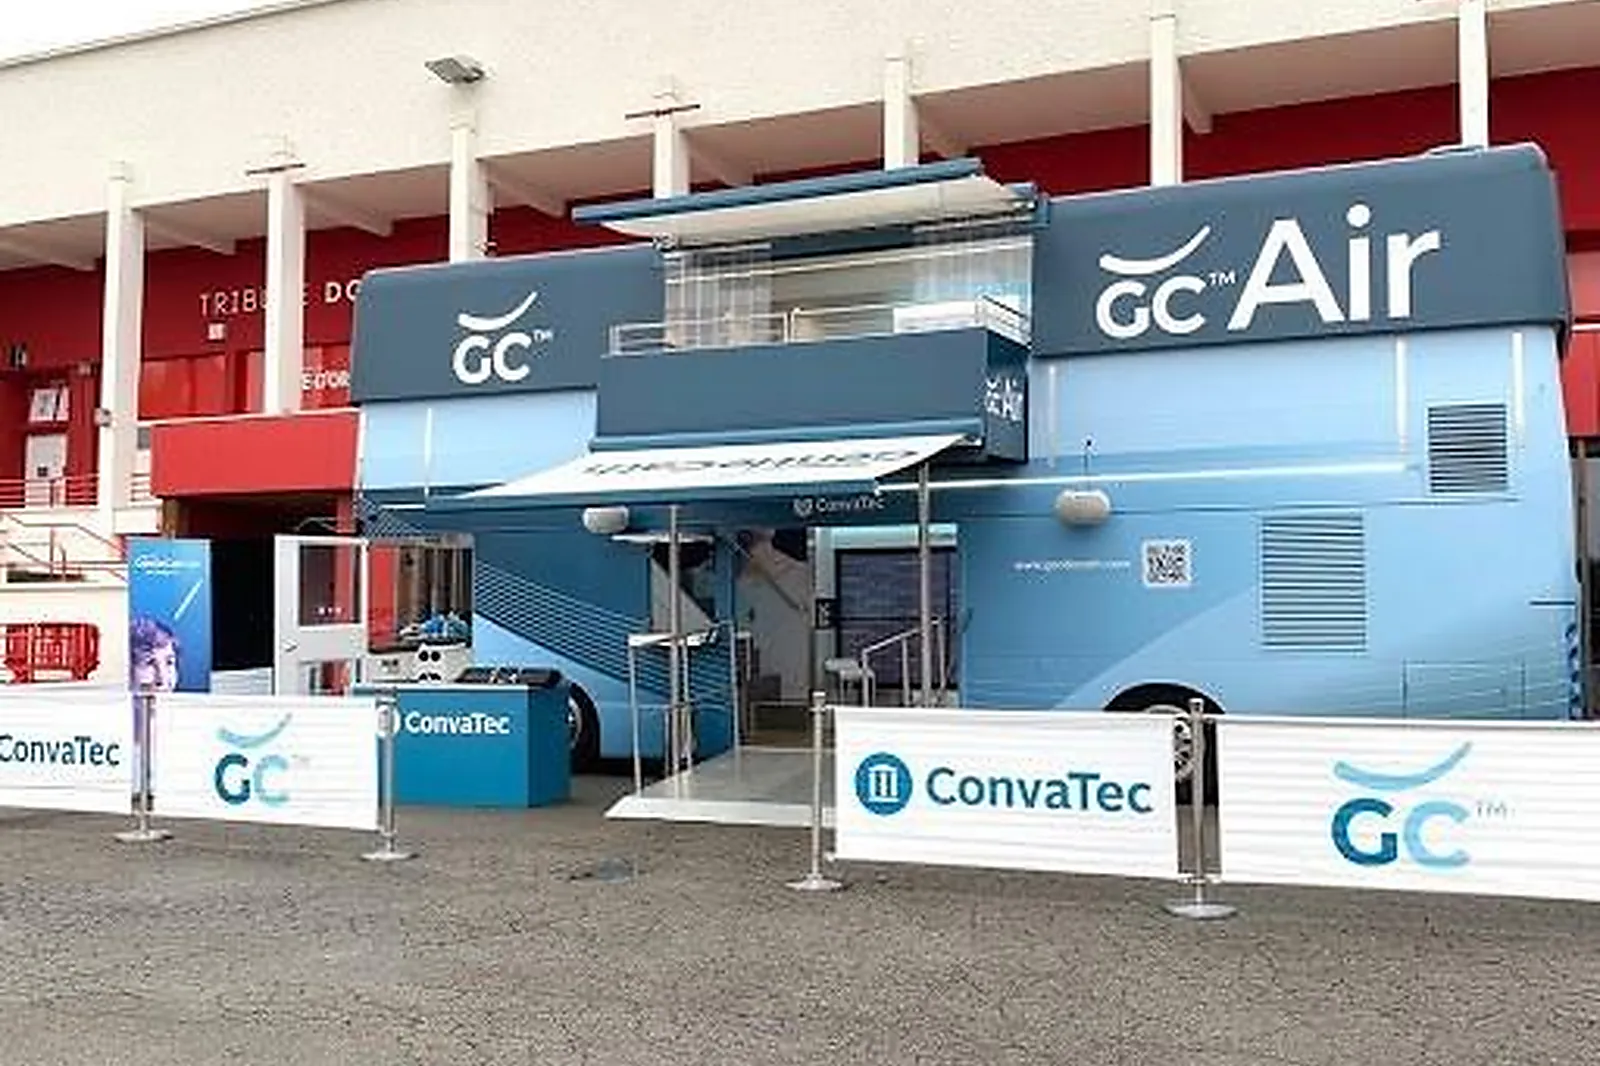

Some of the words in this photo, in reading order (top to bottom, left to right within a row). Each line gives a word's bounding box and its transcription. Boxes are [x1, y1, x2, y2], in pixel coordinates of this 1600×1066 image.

[1227, 203, 1441, 331] Air
[404, 711, 510, 735] ConvaTec
[0, 735, 120, 766] ConvaTec
[925, 766, 1154, 814] ConvaTec
